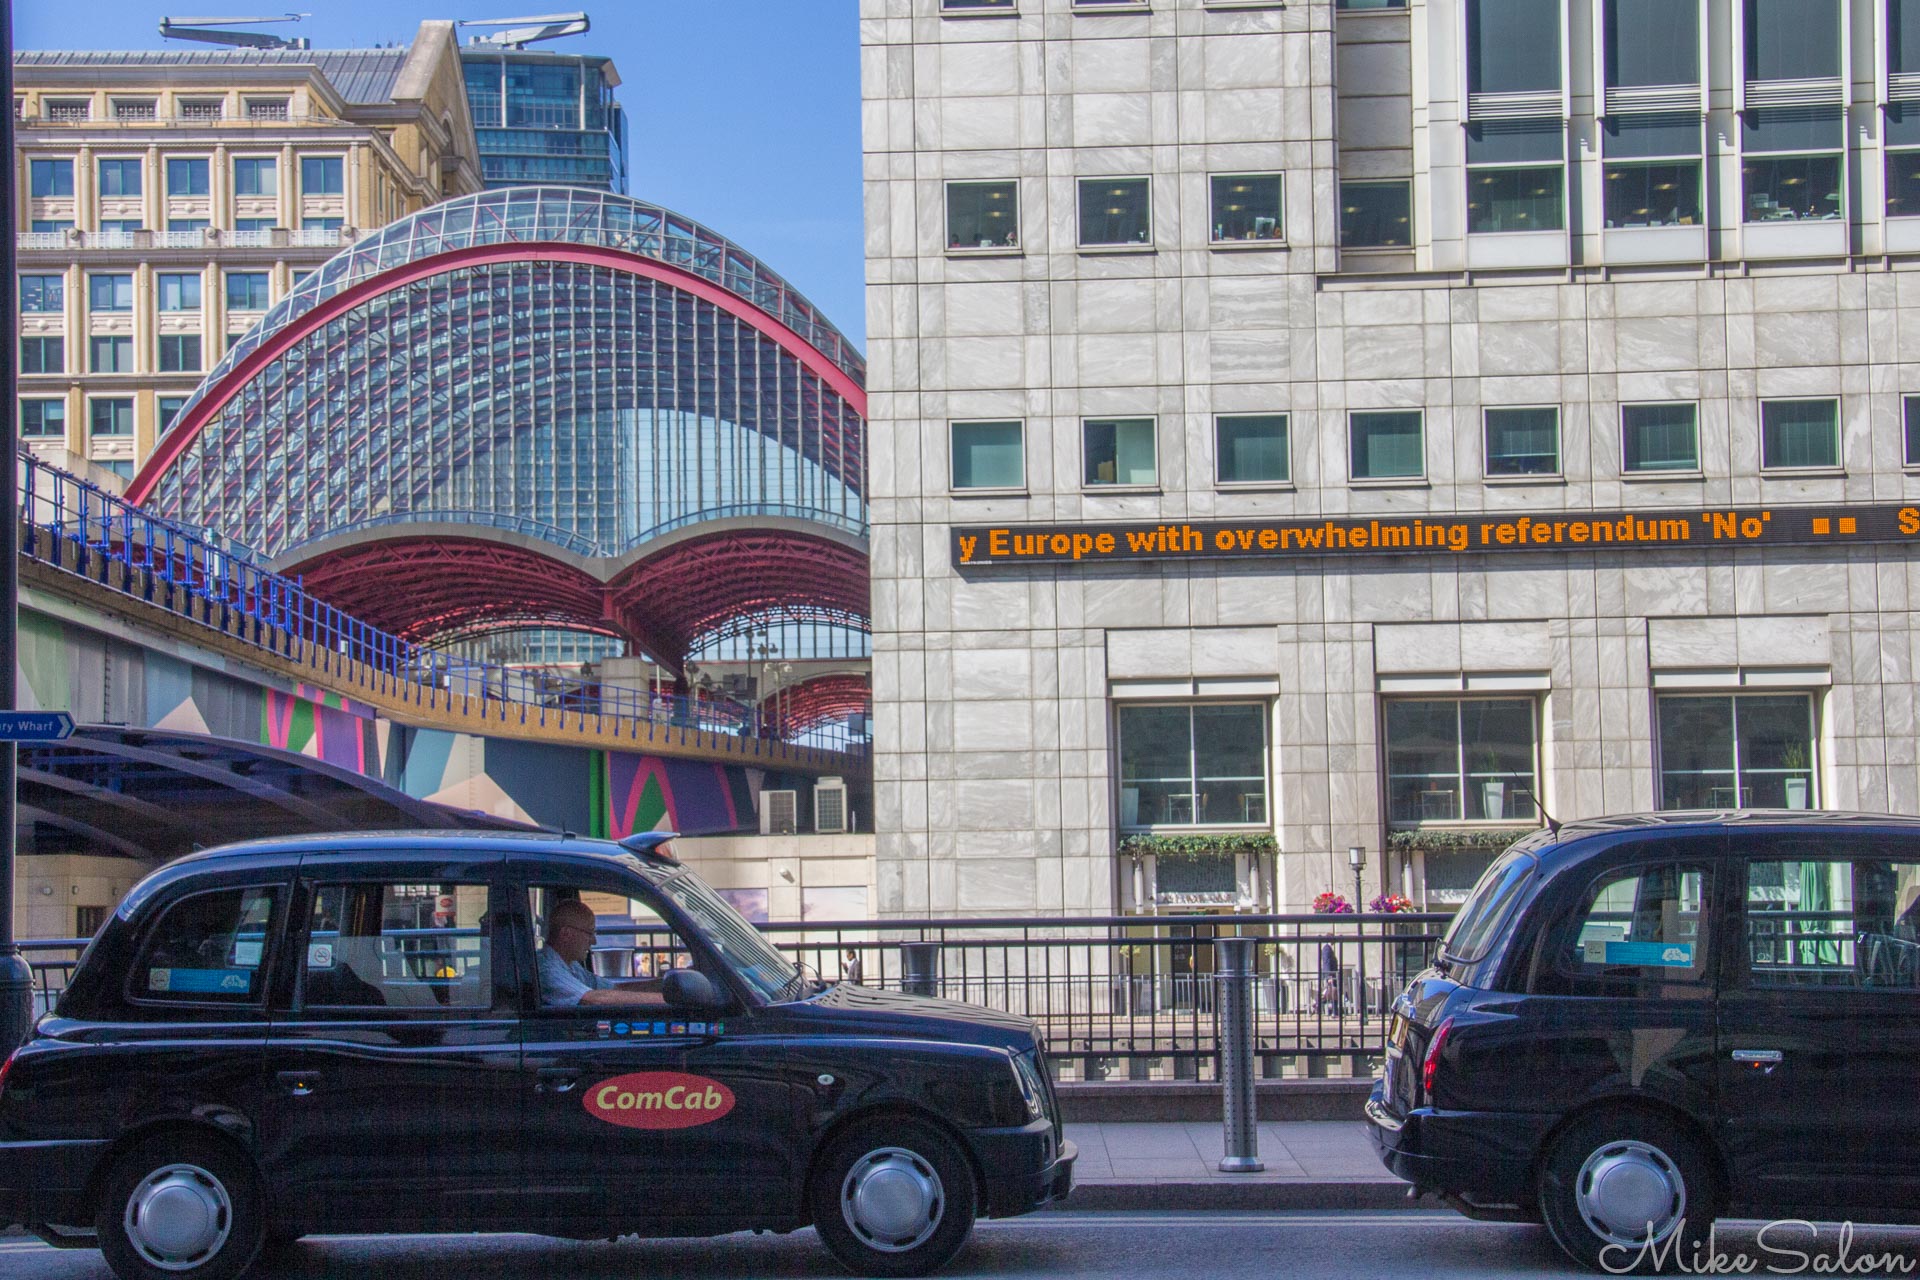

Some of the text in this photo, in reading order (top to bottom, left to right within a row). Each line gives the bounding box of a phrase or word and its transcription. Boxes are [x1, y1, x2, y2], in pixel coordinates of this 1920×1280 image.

[960, 536, 976, 562] y
[990, 529, 1115, 559] Europe
[1126, 525, 1203, 552] with
[1215, 520, 1468, 550] overwhelming
[1481, 514, 1690, 544] referendum
[1702, 511, 1771, 539] 'No'
[0, 721, 53, 733] ry Wharf
[596, 1085, 722, 1110] ComCab
